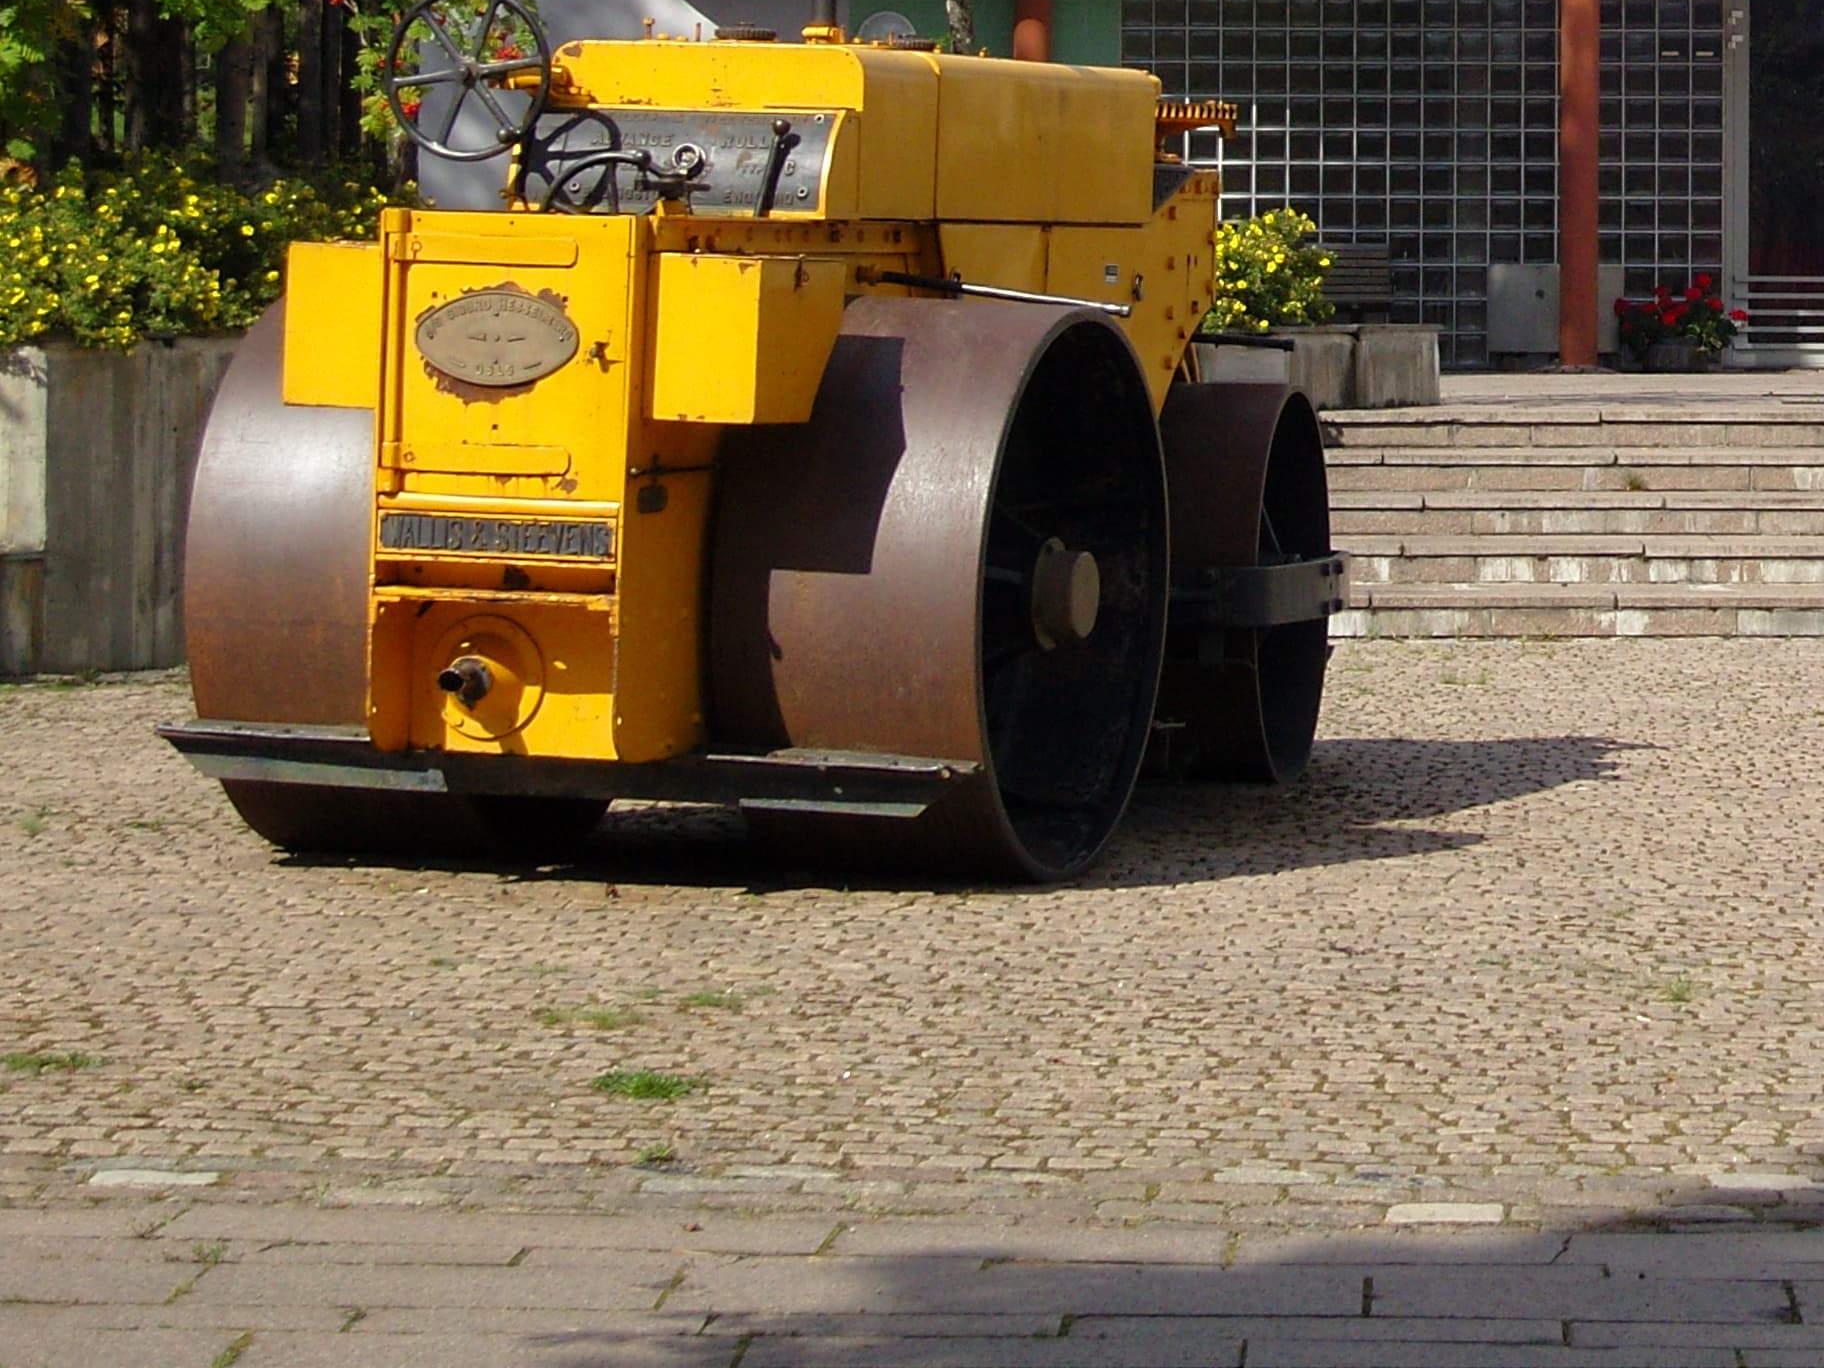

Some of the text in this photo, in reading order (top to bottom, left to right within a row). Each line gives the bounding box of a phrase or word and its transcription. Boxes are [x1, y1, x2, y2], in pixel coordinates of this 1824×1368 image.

[720, 135, 785, 150] ROLL
[722, 189, 795, 205] ENGND
[385, 514, 611, 557] WALLIS & STEEVENS
